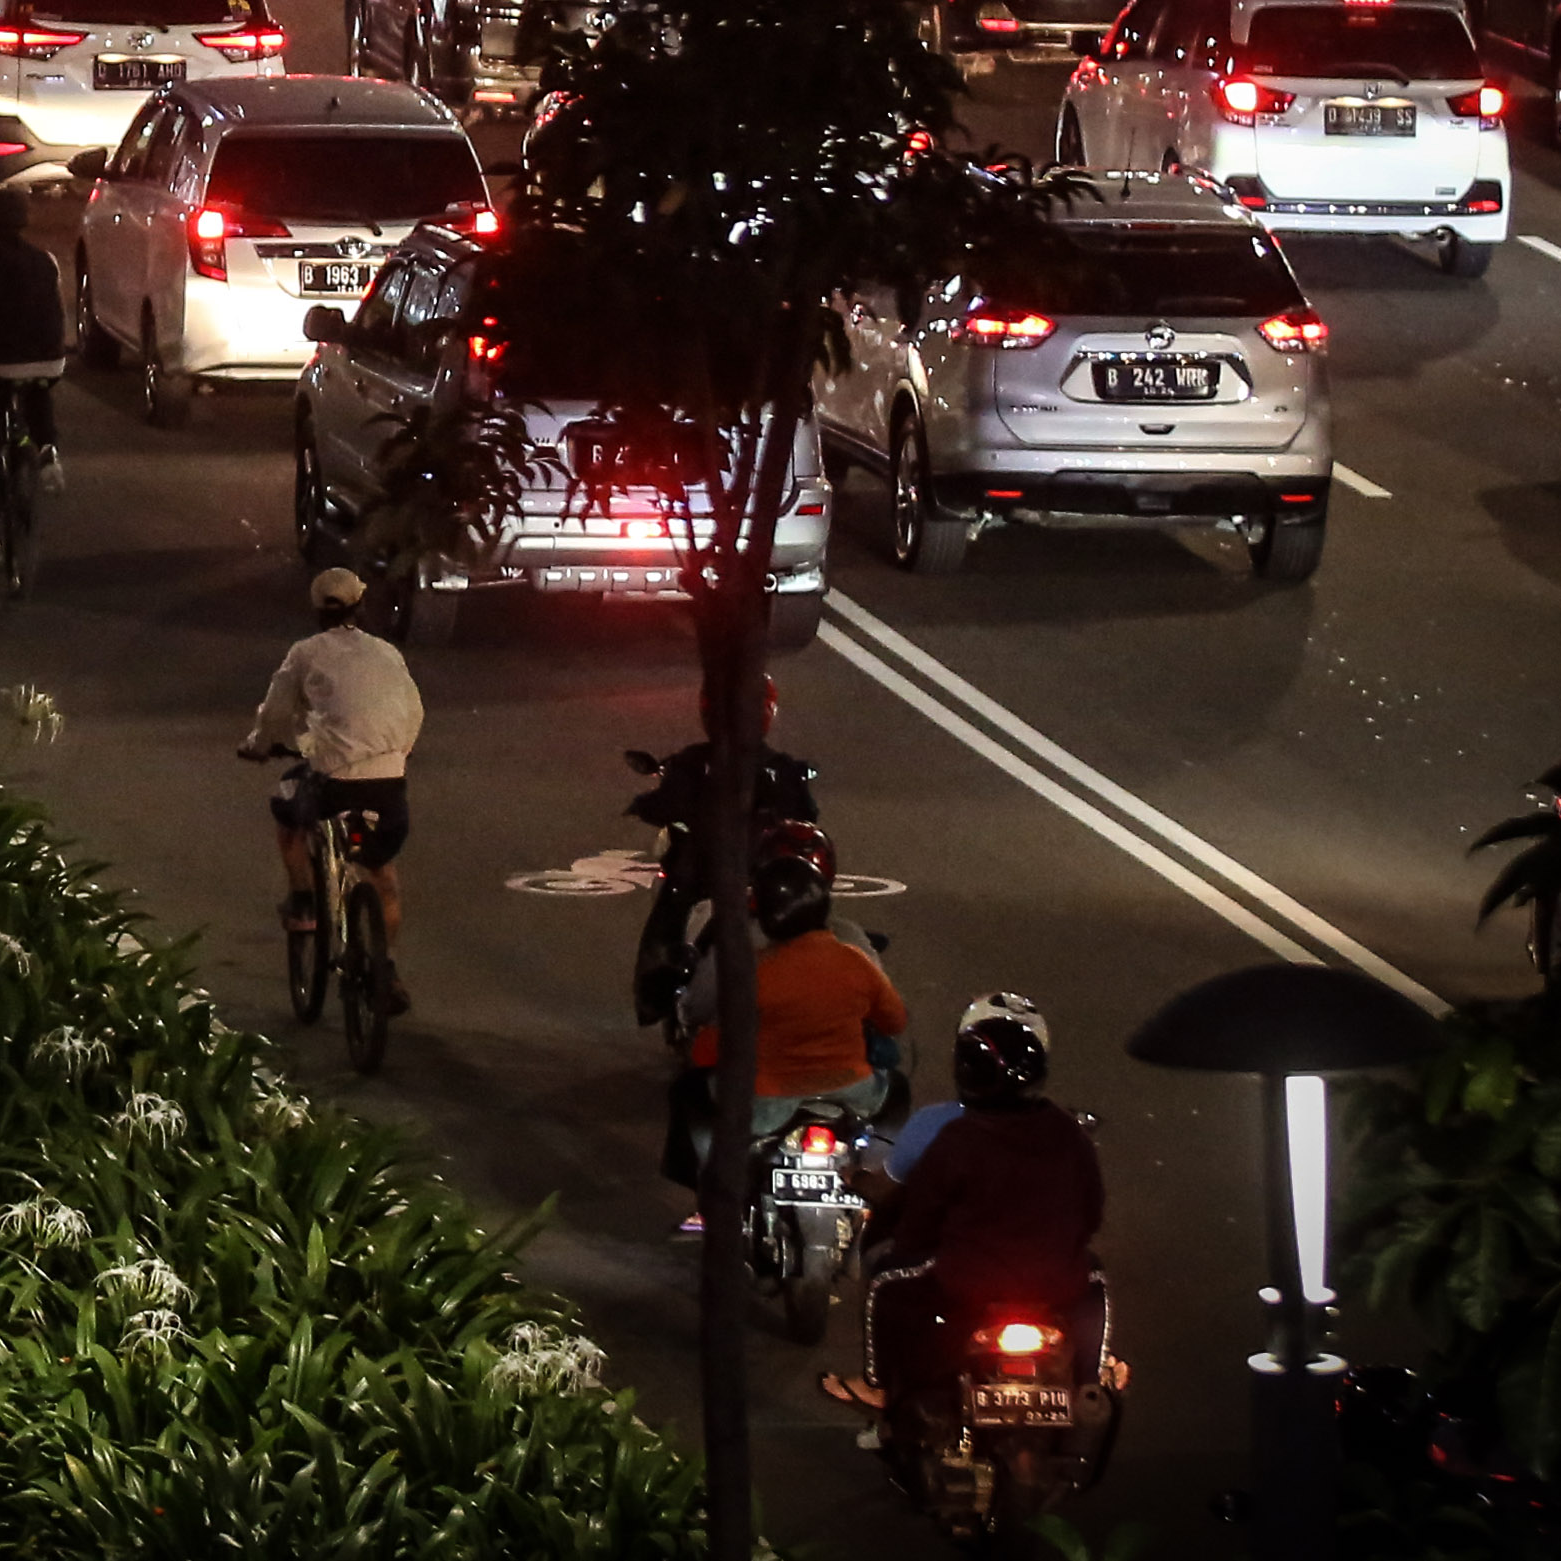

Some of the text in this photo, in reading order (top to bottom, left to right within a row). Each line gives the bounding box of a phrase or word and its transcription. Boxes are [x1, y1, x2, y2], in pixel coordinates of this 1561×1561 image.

[304, 265, 314, 284] B
[326, 265, 359, 285] 1963
[1108, 368, 1118, 387] B
[1133, 368, 1165, 387] 242
[776, 1172, 785, 1188] B
[977, 1391, 988, 1406] B
[994, 1391, 1030, 1406] 3773
